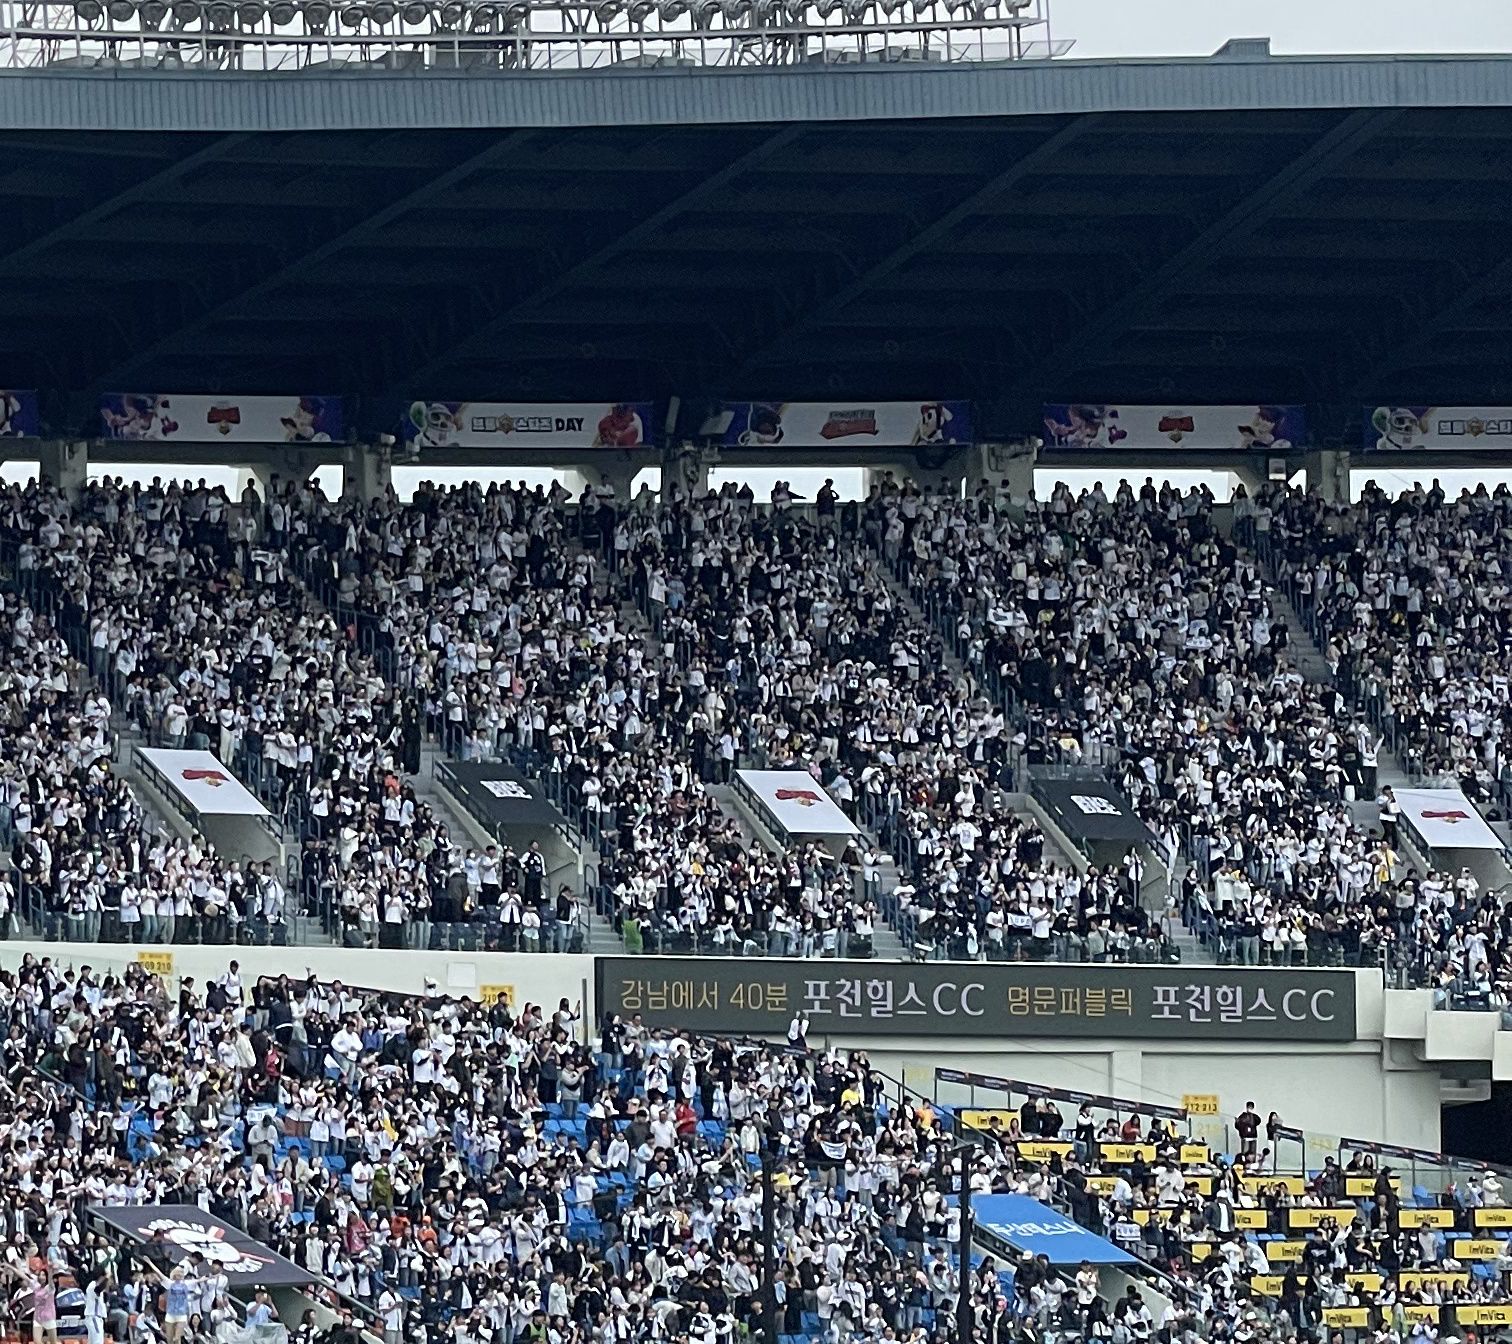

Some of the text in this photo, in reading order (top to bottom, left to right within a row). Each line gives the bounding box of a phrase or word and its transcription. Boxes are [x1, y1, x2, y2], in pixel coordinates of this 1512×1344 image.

[554, 417, 585, 432] DAY
[620, 978, 1336, 1023] 강남에서 40분 포천힐스CC 명문퍼블릭 포천힐스CC
